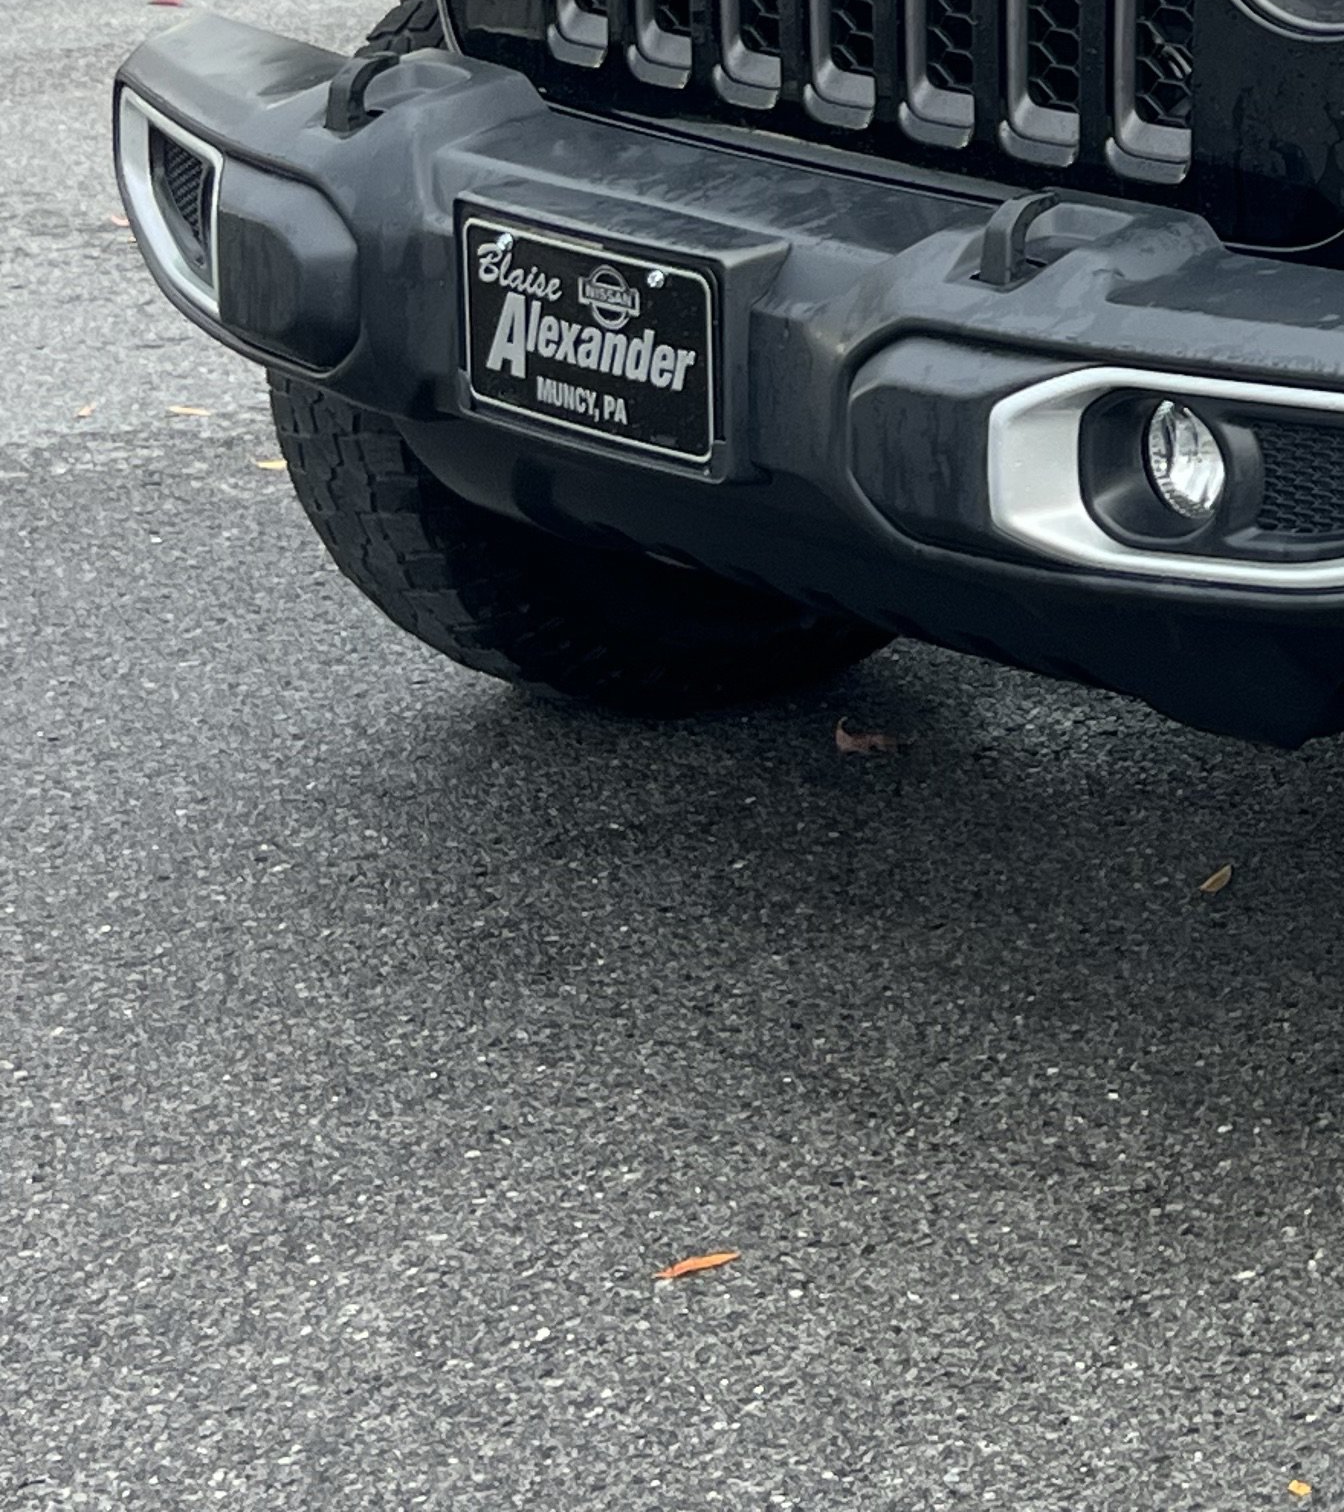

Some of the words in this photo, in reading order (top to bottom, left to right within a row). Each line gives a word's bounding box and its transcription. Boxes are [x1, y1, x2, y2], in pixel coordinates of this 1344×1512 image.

[477, 242, 563, 301] Blaise
[585, 284, 633, 308] NISSAN
[486, 290, 696, 392] Alexander
[536, 375, 600, 422] MUNCY,
[602, 394, 628, 425] PA
